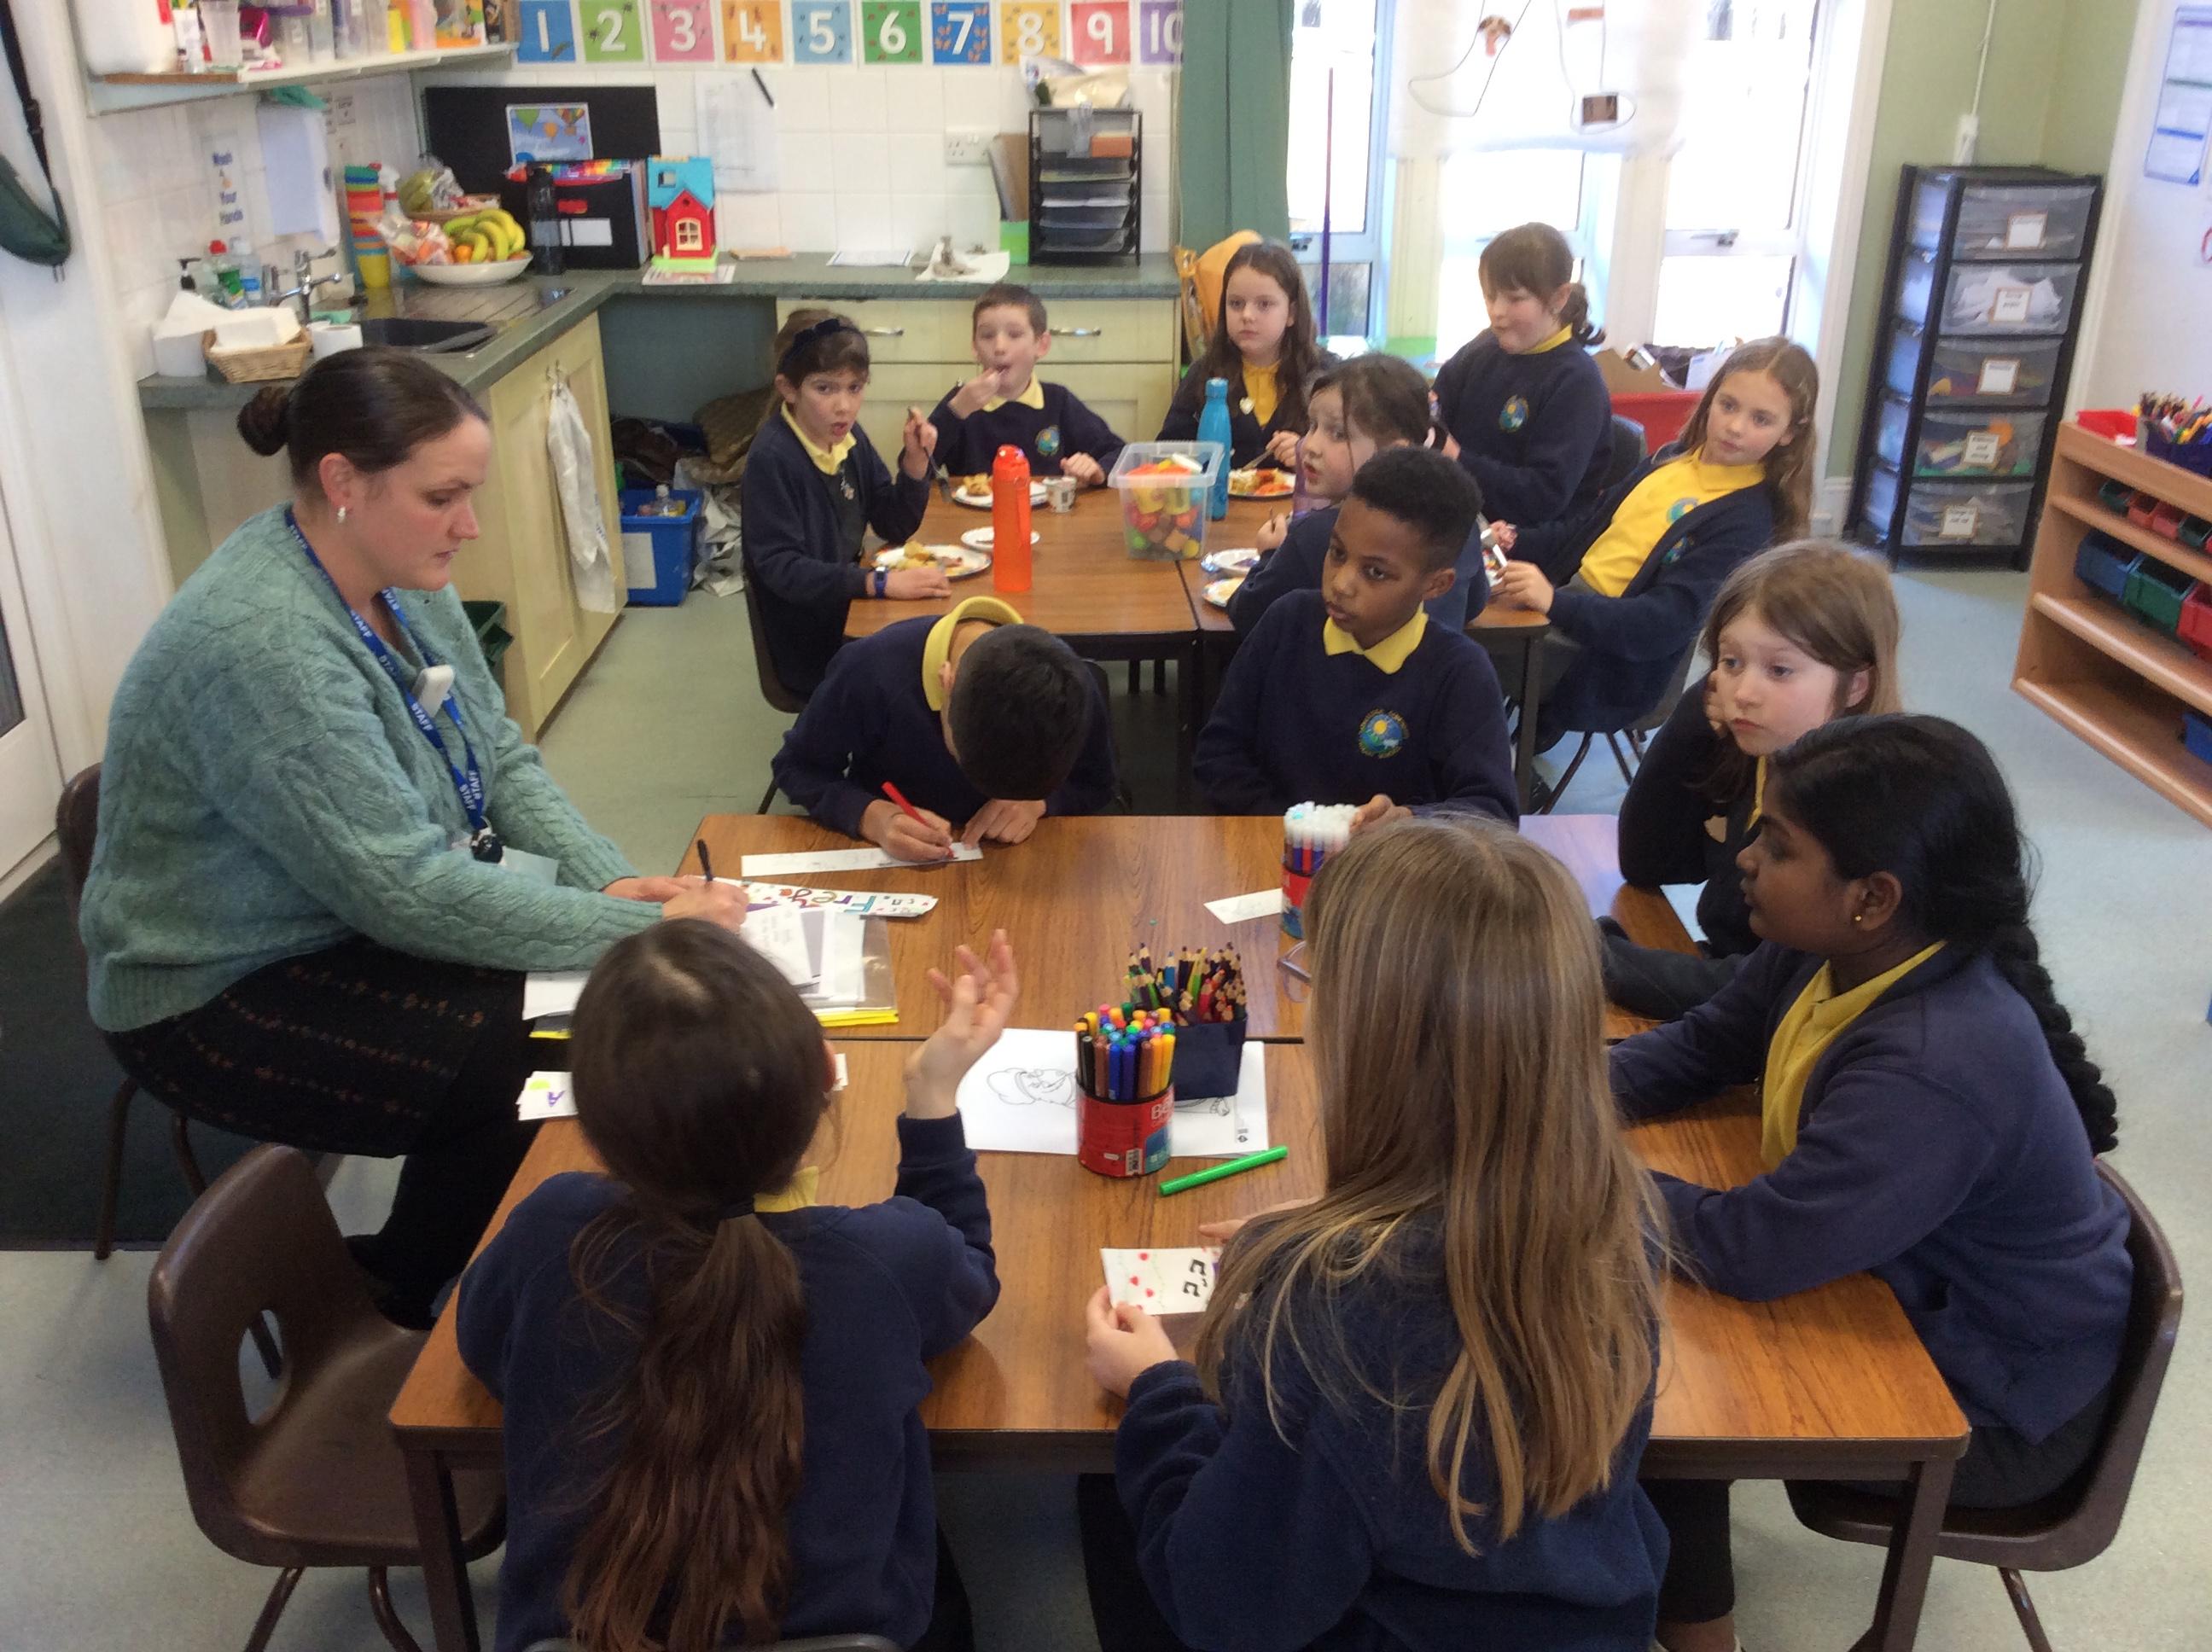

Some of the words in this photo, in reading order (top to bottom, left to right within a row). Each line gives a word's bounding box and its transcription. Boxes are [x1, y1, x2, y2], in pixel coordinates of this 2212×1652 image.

[537, 9, 550, 53] 1
[597, 10, 626, 53] 2
[668, 10, 697, 53] 3
[739, 10, 766, 53] 4
[807, 10, 835, 55] 5
[879, 9, 906, 55] 6
[946, 10, 975, 55] 7
[1017, 12, 1045, 56] 8
[1086, 14, 1114, 55] 9
[410, 701, 434, 732] STAFF
[458, 783, 478, 811] STAFF
[468, 769, 482, 800] STAFF
